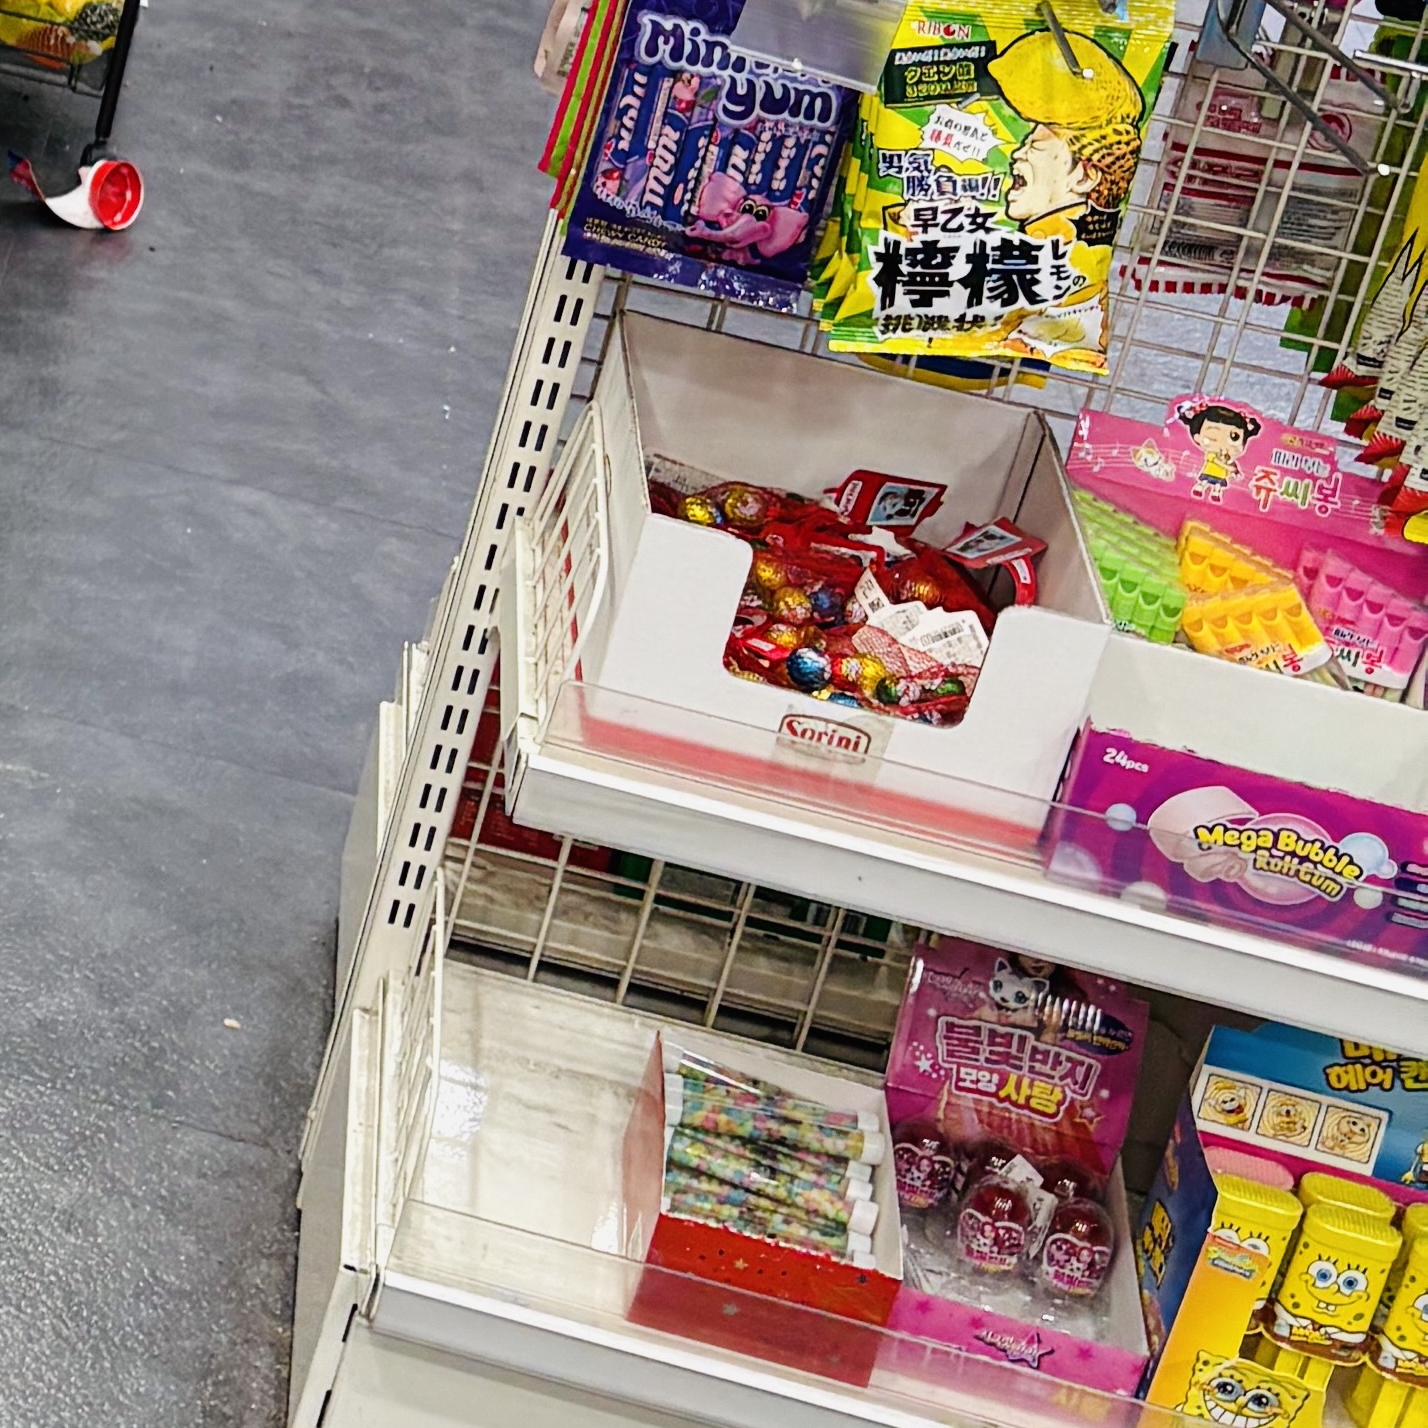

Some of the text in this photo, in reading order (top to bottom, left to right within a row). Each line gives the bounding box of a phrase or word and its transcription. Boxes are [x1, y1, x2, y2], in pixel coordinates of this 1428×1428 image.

[916, 19, 972, 41] RIBON
[720, 75, 835, 124] yum
[913, 206, 1000, 234] 早乙女
[782, 717, 864, 757] Sorini
[1103, 747, 1150, 773] 24pcs
[1195, 823, 1363, 881] Mega Bubble
[1253, 850, 1346, 899] Roll Gum
[998, 1073, 1065, 1114] 사랑
[1326, 1060, 1395, 1093] 헤어
